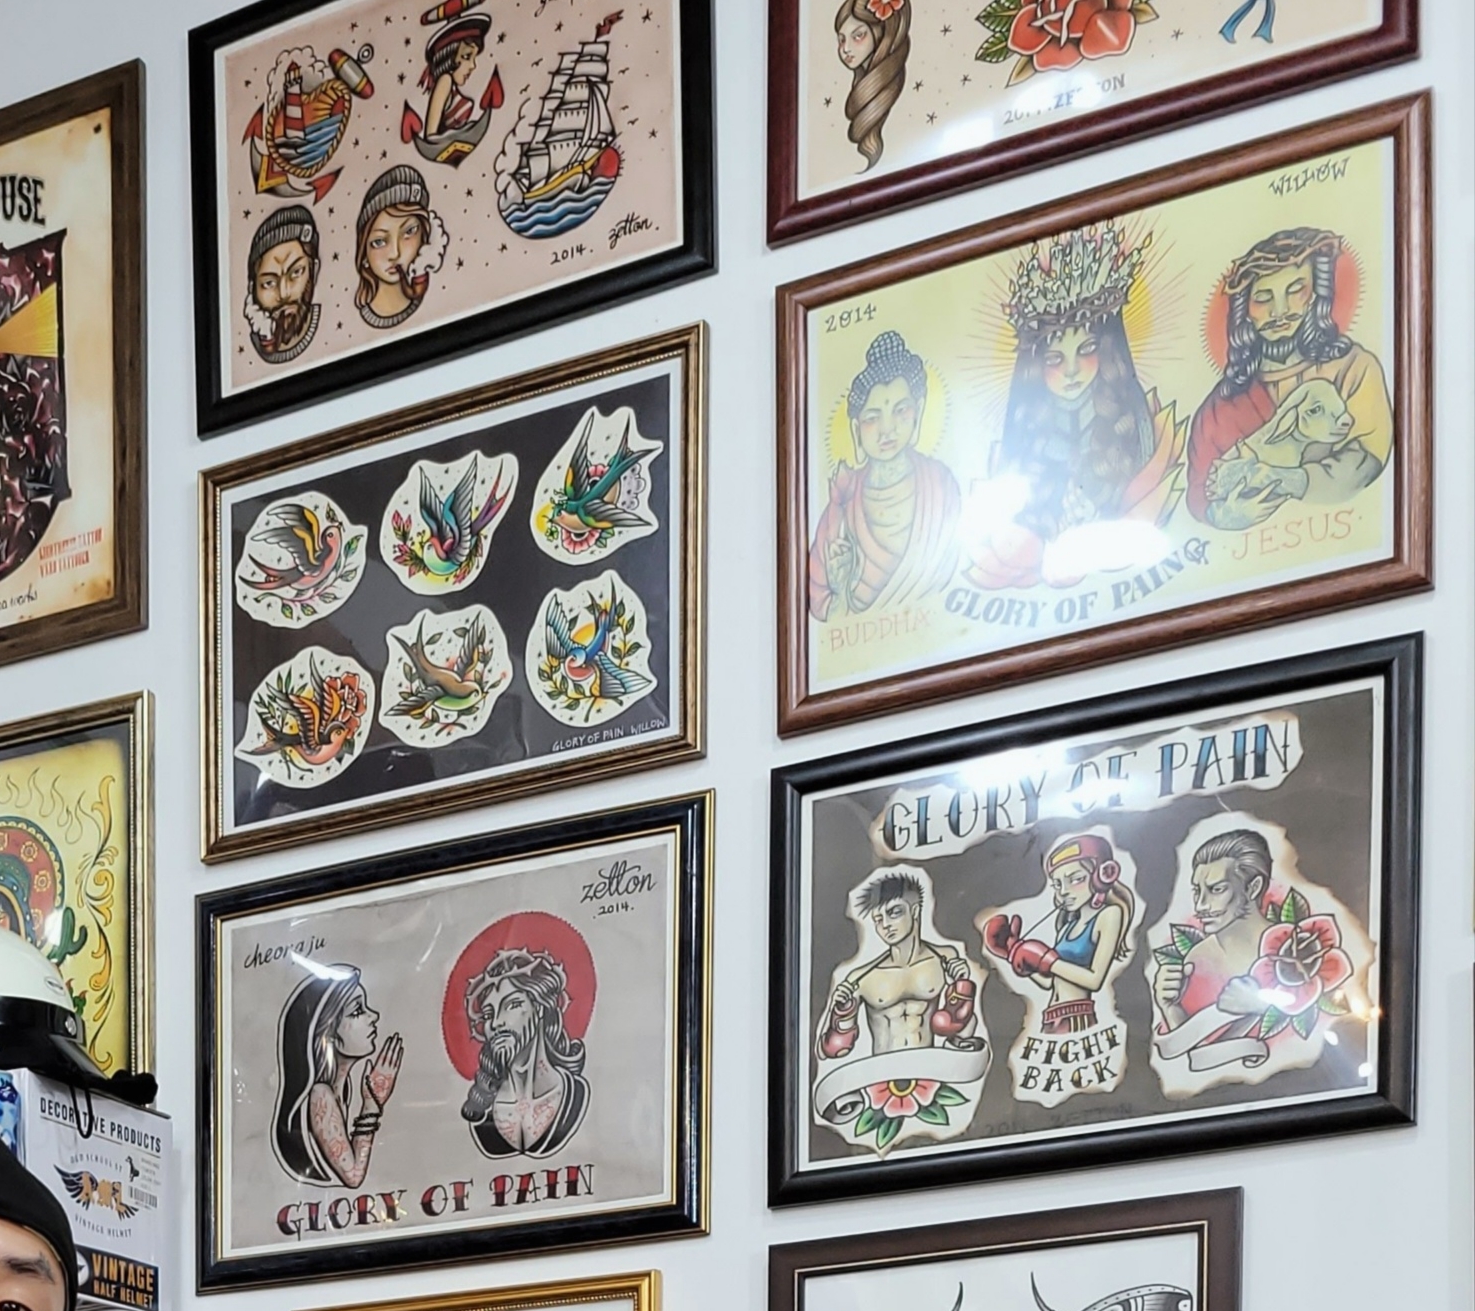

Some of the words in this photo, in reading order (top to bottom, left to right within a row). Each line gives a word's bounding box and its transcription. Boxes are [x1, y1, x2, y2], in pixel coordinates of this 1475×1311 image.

[824, 301, 877, 335] 2014
[1232, 510, 1355, 561] JESUS
[828, 609, 931, 653] BUDDHA
[945, 587, 1048, 629] GLORY
[1054, 591, 1097, 623] OF
[1111, 550, 1186, 610] PAIN
[552, 735, 585, 752] GLORY
[587, 732, 600, 742] OF
[603, 728, 624, 740] PAIN
[630, 719, 666, 735] WILLOW
[880, 768, 1051, 852] GLORY
[1070, 752, 1138, 812] OF
[1158, 718, 1292, 798] PAIN
[1021, 1025, 1123, 1065] FIGHT
[1020, 1055, 1118, 1093] BACK
[110, 1121, 161, 1153] PRODUCTS
[276, 1190, 408, 1241] GLORY
[420, 1179, 475, 1217] OF
[489, 1164, 595, 1208] PAIN
[92, 1253, 154, 1291] VINTAGE
[93, 1279, 116, 1298] HALF
[120, 1286, 153, 1309] HELMET
